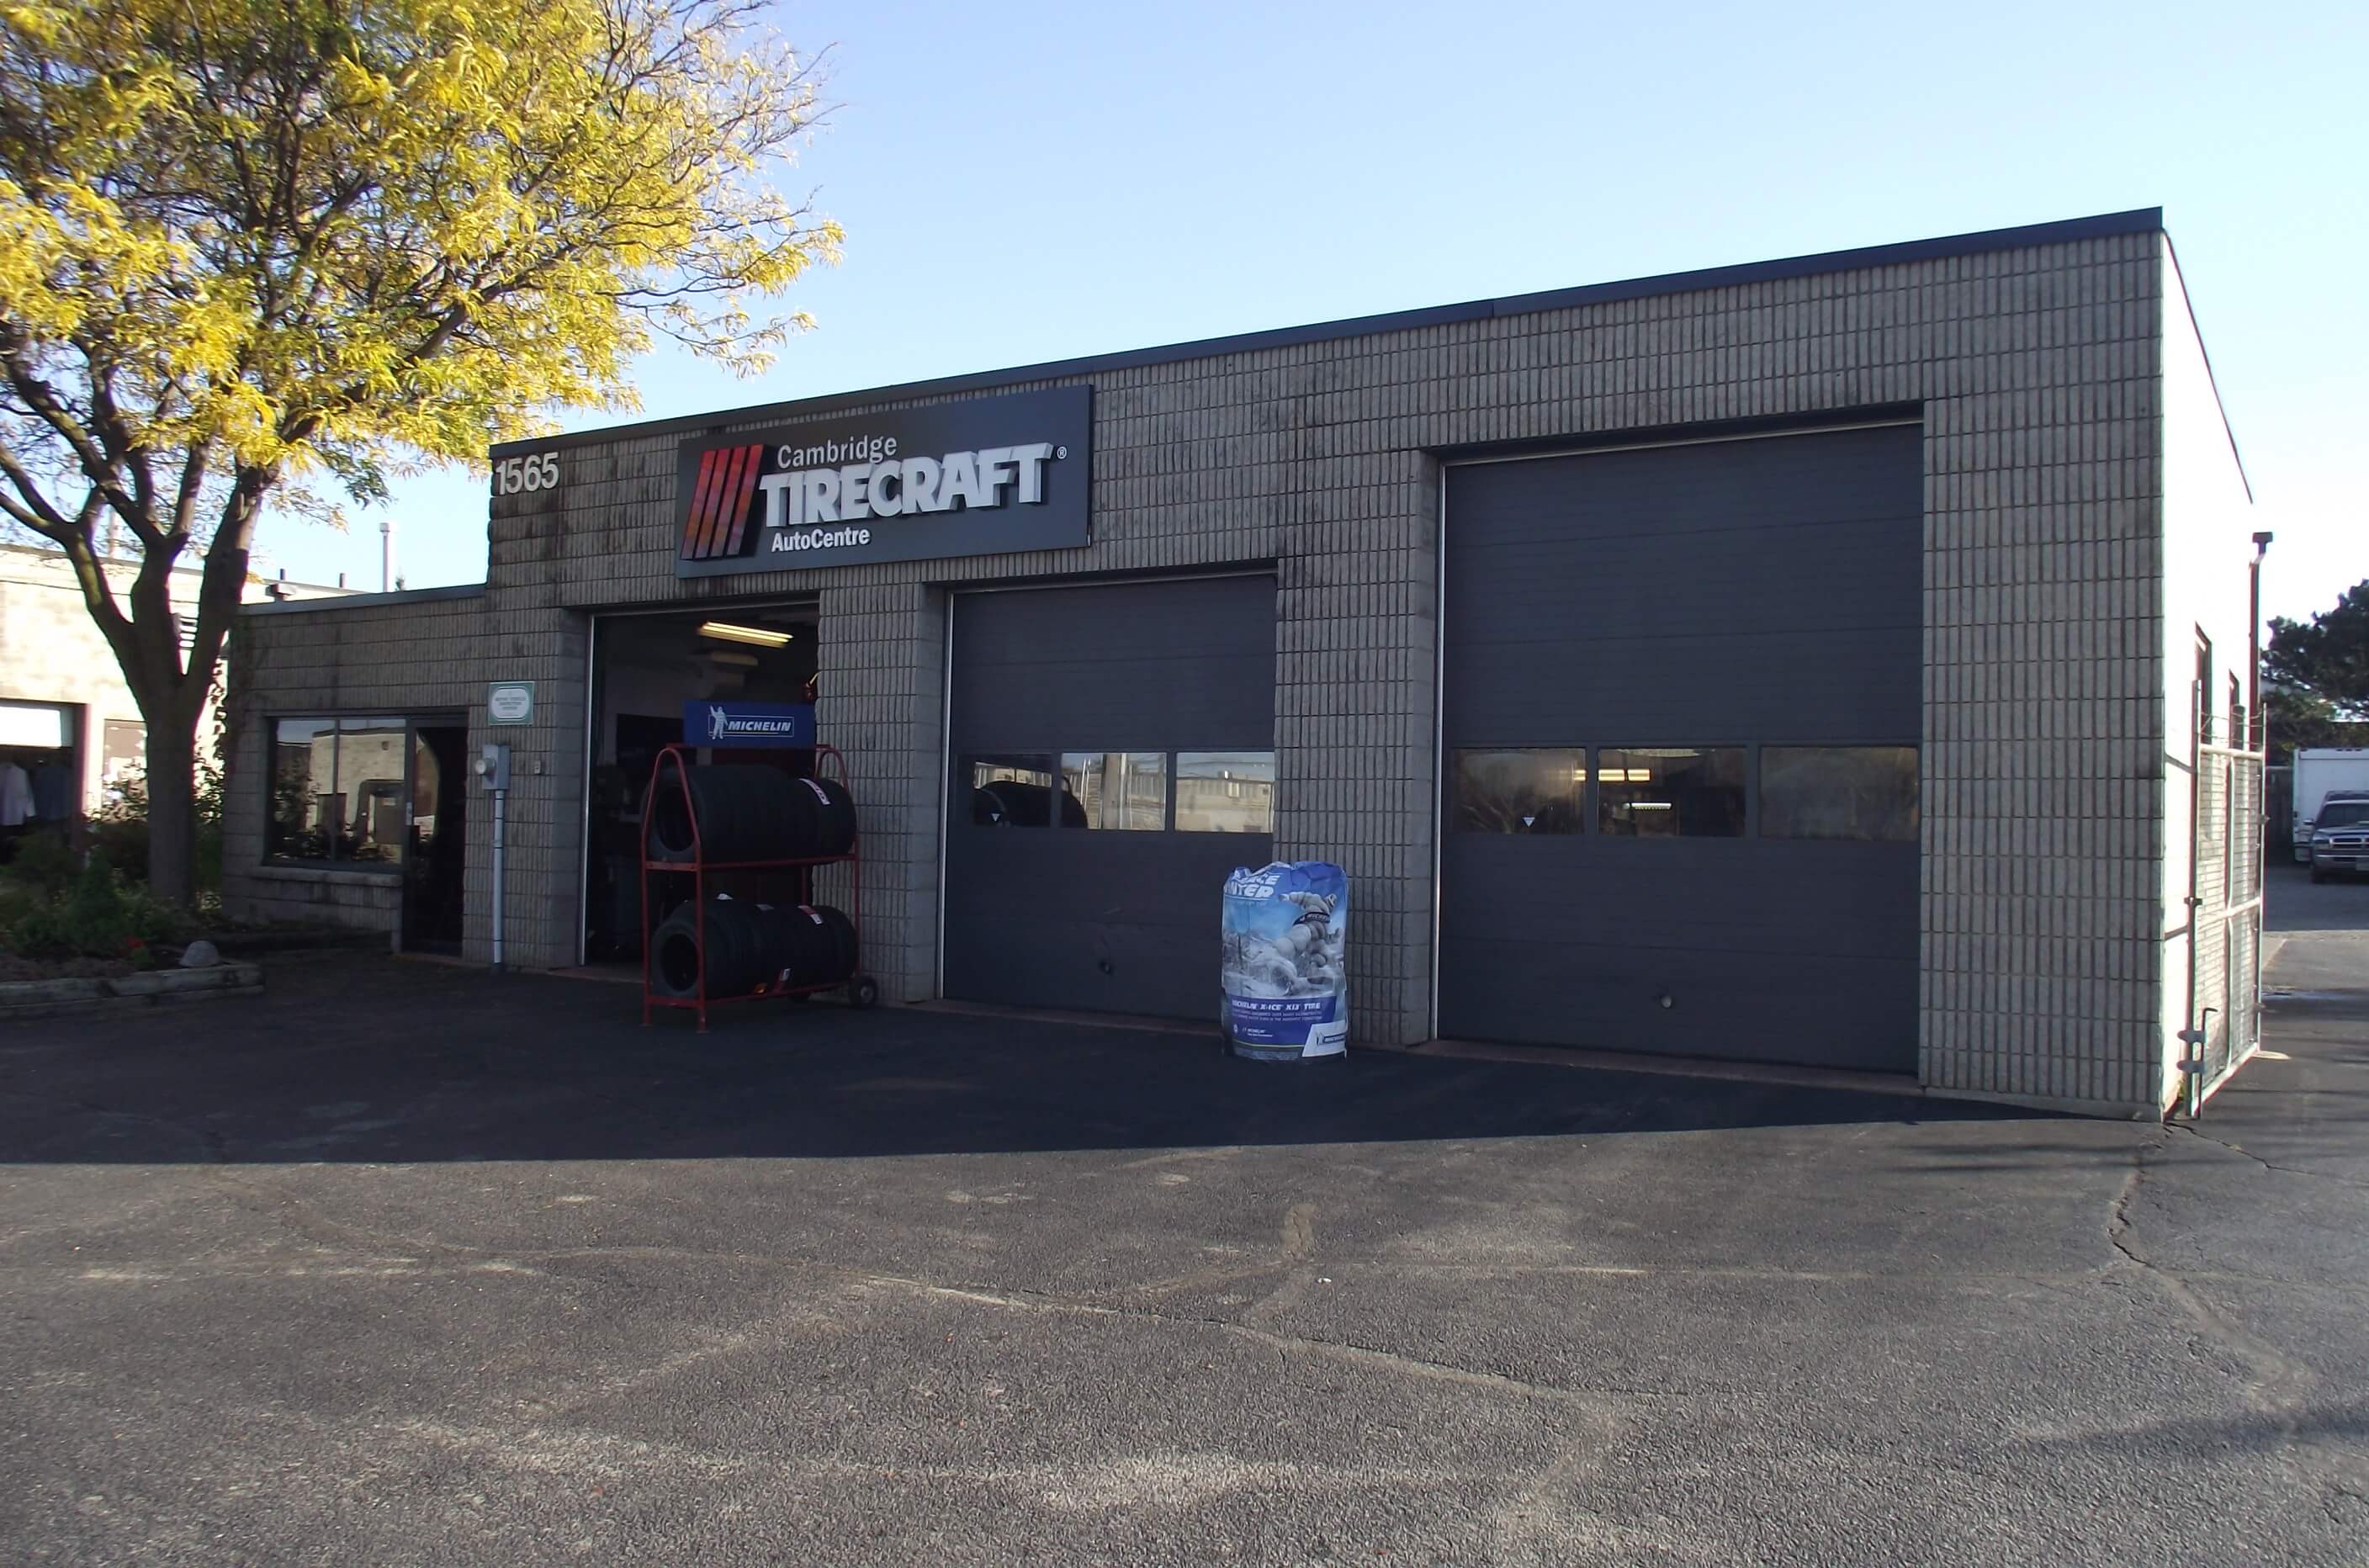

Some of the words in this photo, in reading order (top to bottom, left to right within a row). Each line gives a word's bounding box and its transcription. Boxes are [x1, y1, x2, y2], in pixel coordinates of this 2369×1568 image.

[776, 434, 898, 469] Cambridge
[495, 451, 560, 495] 1565
[759, 442, 1055, 527] TIRECRAFT
[771, 526, 872, 554] AutoCentre
[727, 720, 792, 732] MICHELIN
